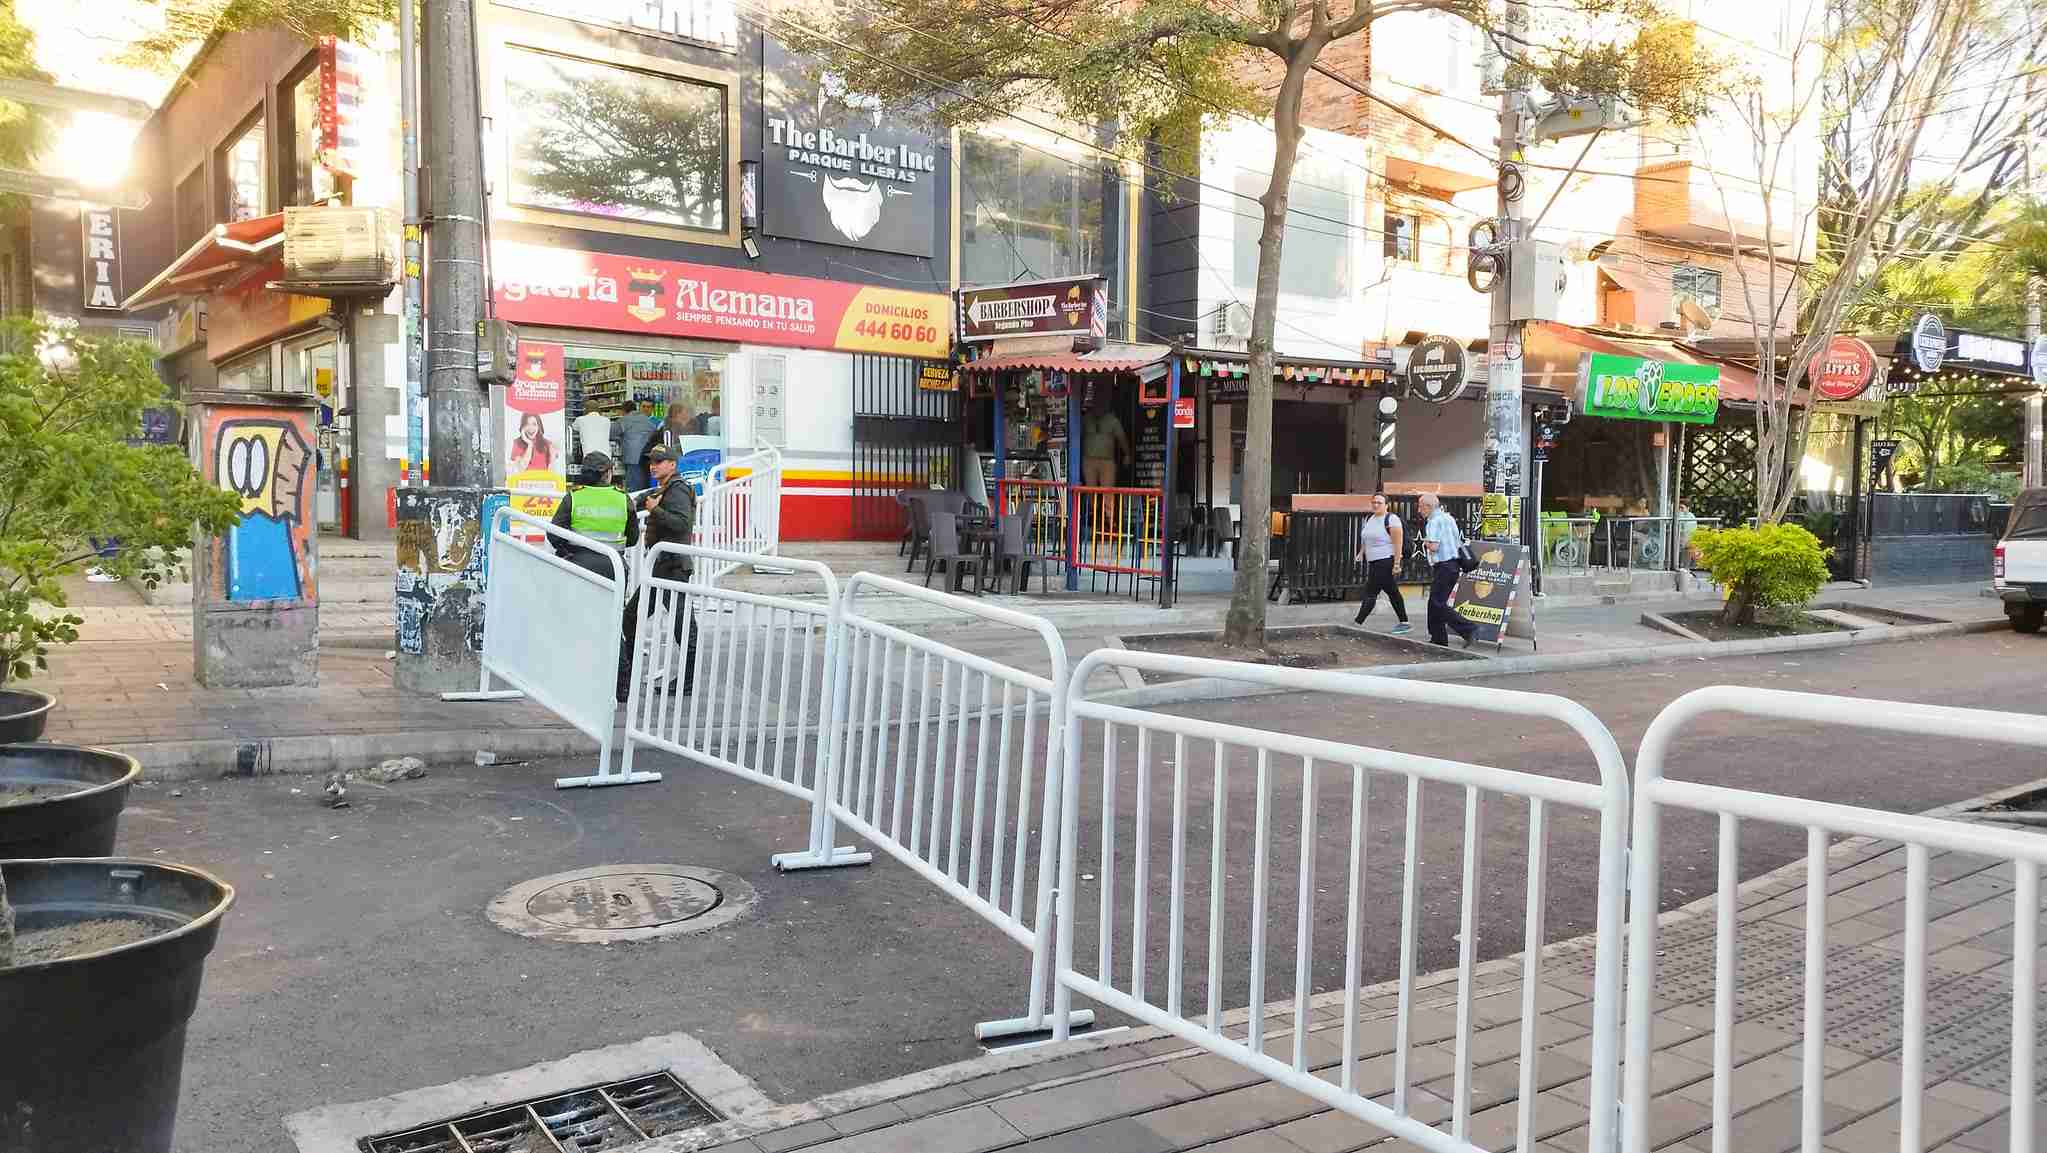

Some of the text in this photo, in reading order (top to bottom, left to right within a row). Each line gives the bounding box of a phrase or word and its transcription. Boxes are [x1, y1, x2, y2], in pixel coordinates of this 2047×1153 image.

[768, 118, 935, 171] The Barber Inc
[788, 149, 916, 183] PARQUE LLERAS
[675, 278, 815, 322] Alemana
[865, 302, 928, 320] DOMICILIOS
[980, 298, 1050, 321] BARBERSHOP
[675, 311, 815, 335] SIEMPRE PENSANDO EN TU SALUD
[855, 319, 937, 344] 444 60 60
[1596, 374, 1640, 409] LOS
[1458, 606, 1501, 624] Barbershop
